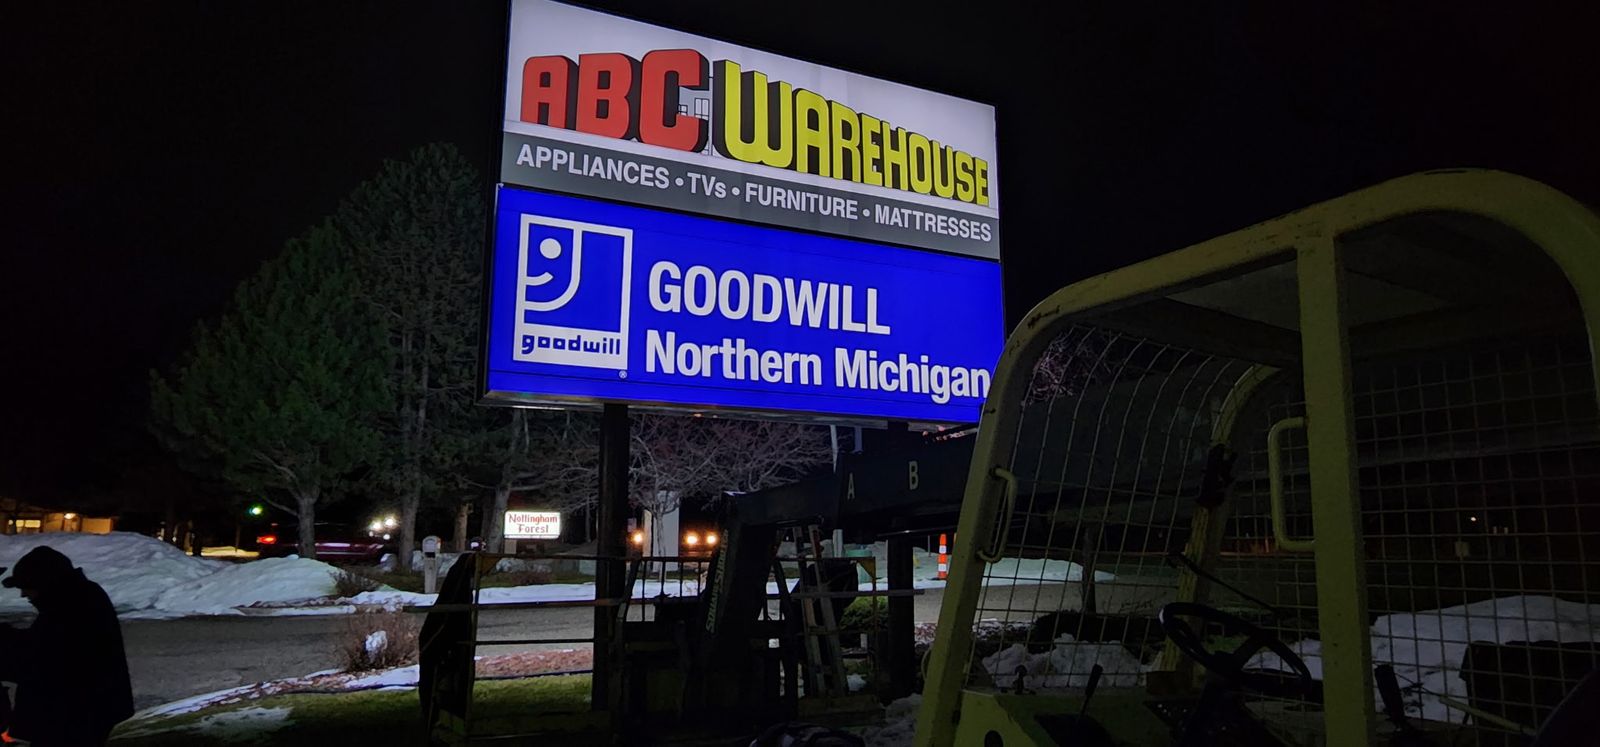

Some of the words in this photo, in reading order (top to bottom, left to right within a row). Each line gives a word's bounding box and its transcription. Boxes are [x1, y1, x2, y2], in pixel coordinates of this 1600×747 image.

[520, 49, 710, 153] ABC
[714, 59, 990, 207] WAREHOUSE
[516, 143, 670, 189] APPLIANCES
[687, 172, 727, 199] TVs
[745, 182, 859, 221] FURNITURE
[874, 203, 992, 243] MATTRESSES
[648, 261, 891, 336] GOODWILL
[521, 334, 620, 355] goodwill
[645, 330, 822, 386] Northern
[835, 347, 991, 404] Michigan
[908, 460, 920, 491] B
